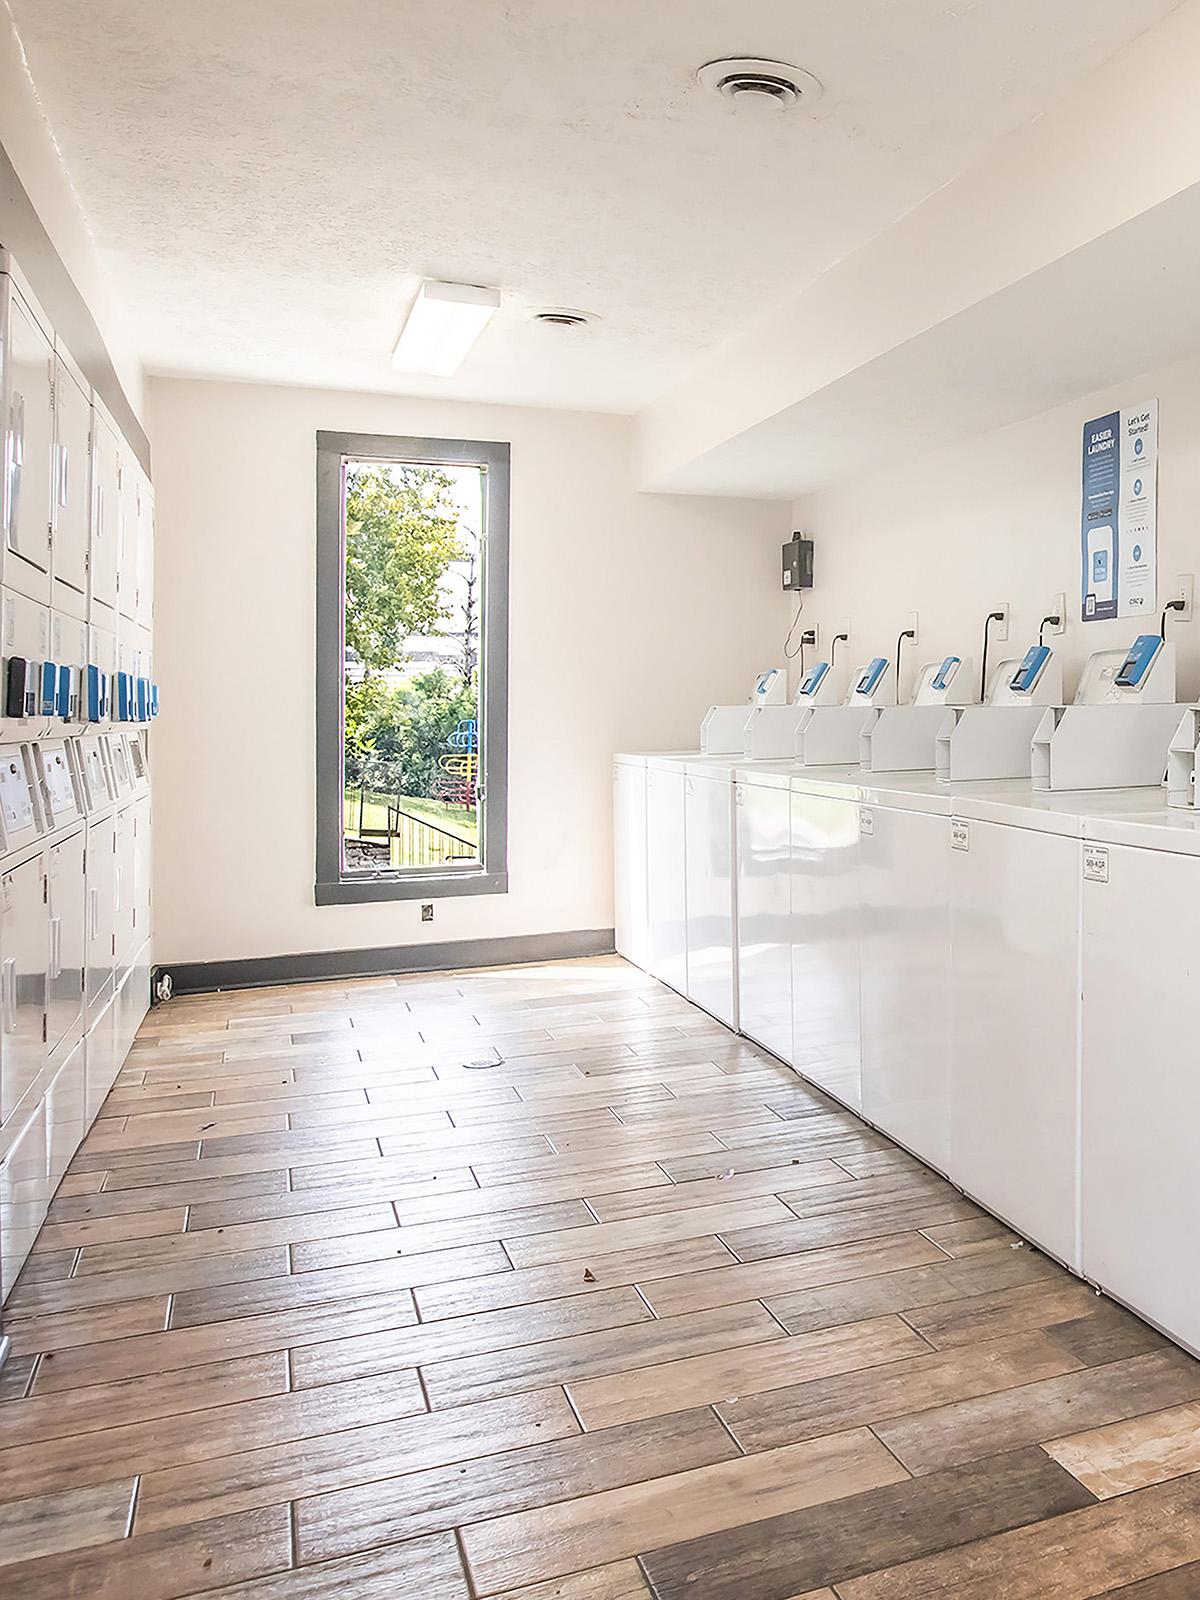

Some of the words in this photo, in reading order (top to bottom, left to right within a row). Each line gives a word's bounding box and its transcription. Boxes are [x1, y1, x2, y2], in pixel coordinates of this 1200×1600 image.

[1127, 416, 1140, 427] Let's
[1140, 412, 1151, 422] Get
[1091, 428, 1113, 444] EASIER
[1087, 438, 1116, 455] LAUNDRY
